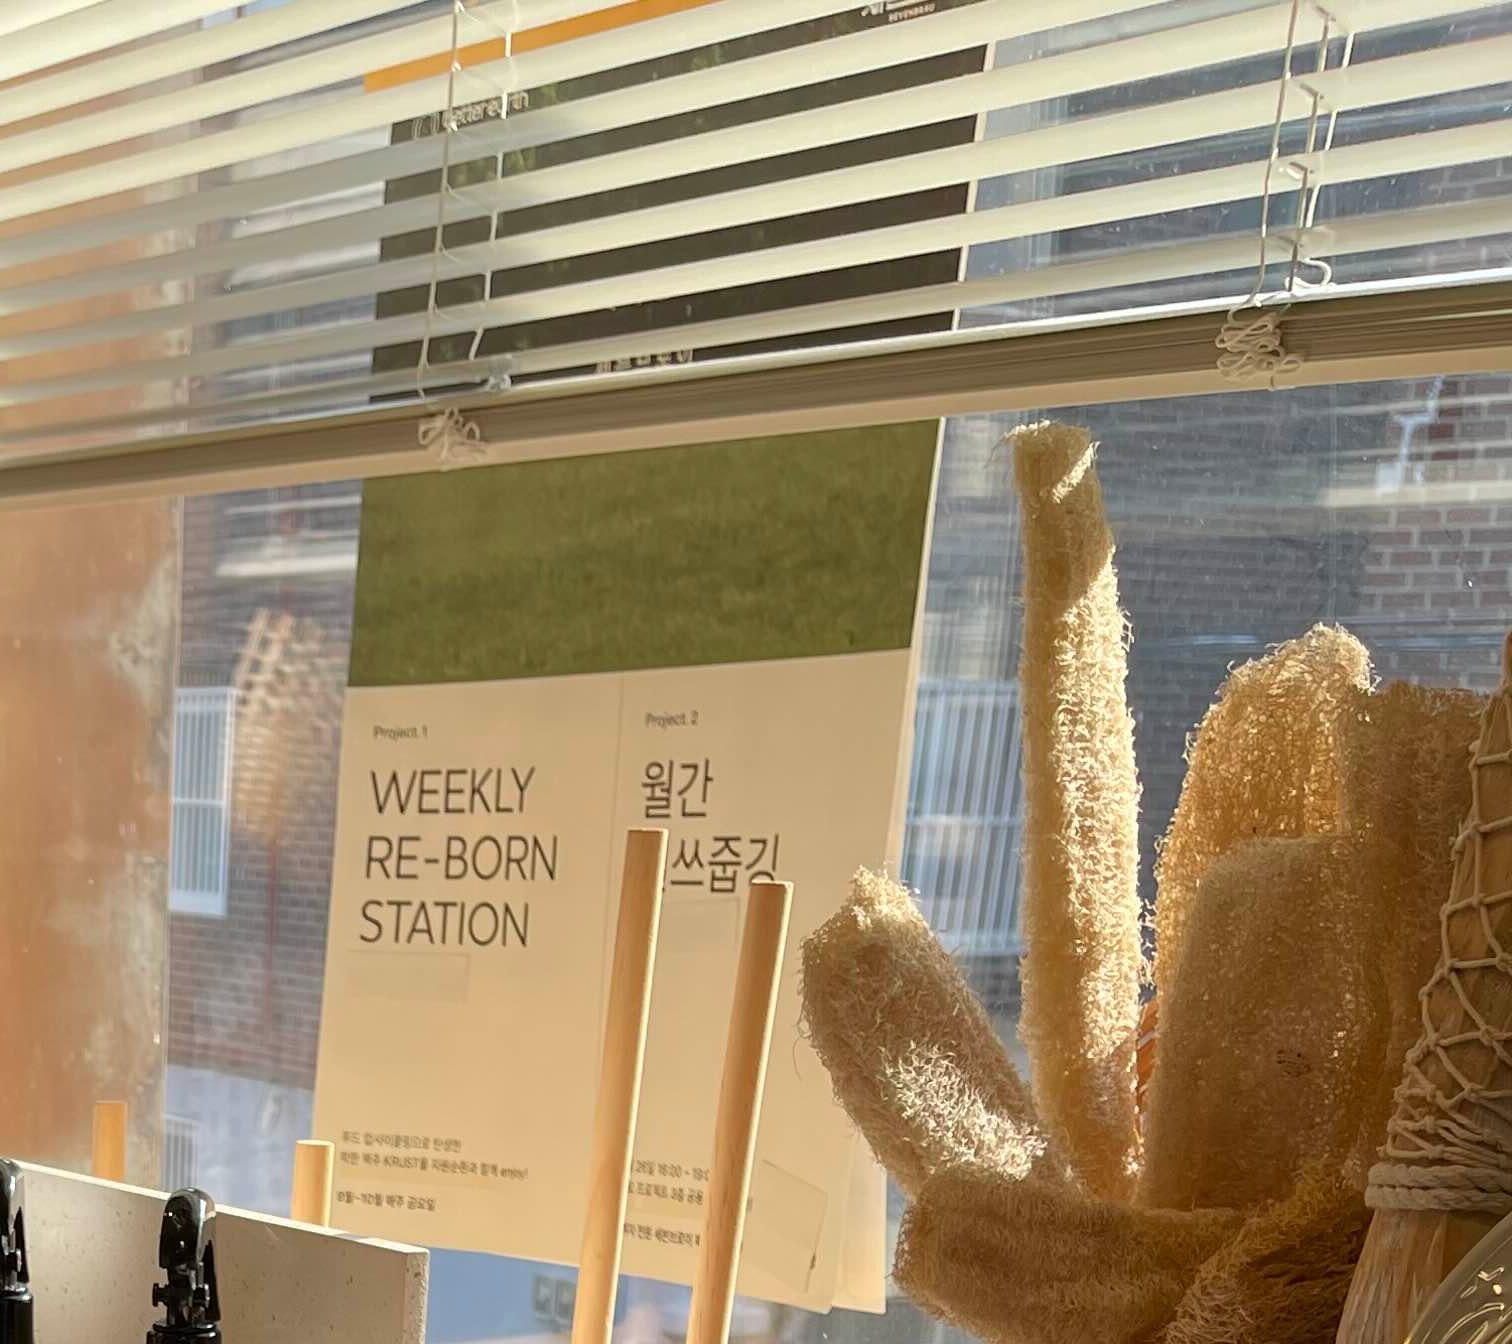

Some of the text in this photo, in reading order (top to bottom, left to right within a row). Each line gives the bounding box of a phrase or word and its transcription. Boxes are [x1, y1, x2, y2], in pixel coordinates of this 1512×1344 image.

[370, 766, 536, 816] WEEKLY
[641, 757, 714, 819] 월간
[366, 834, 558, 882] RE-BORN
[662, 832, 781, 894] 쓰줍깅
[359, 899, 530, 948] STATION
